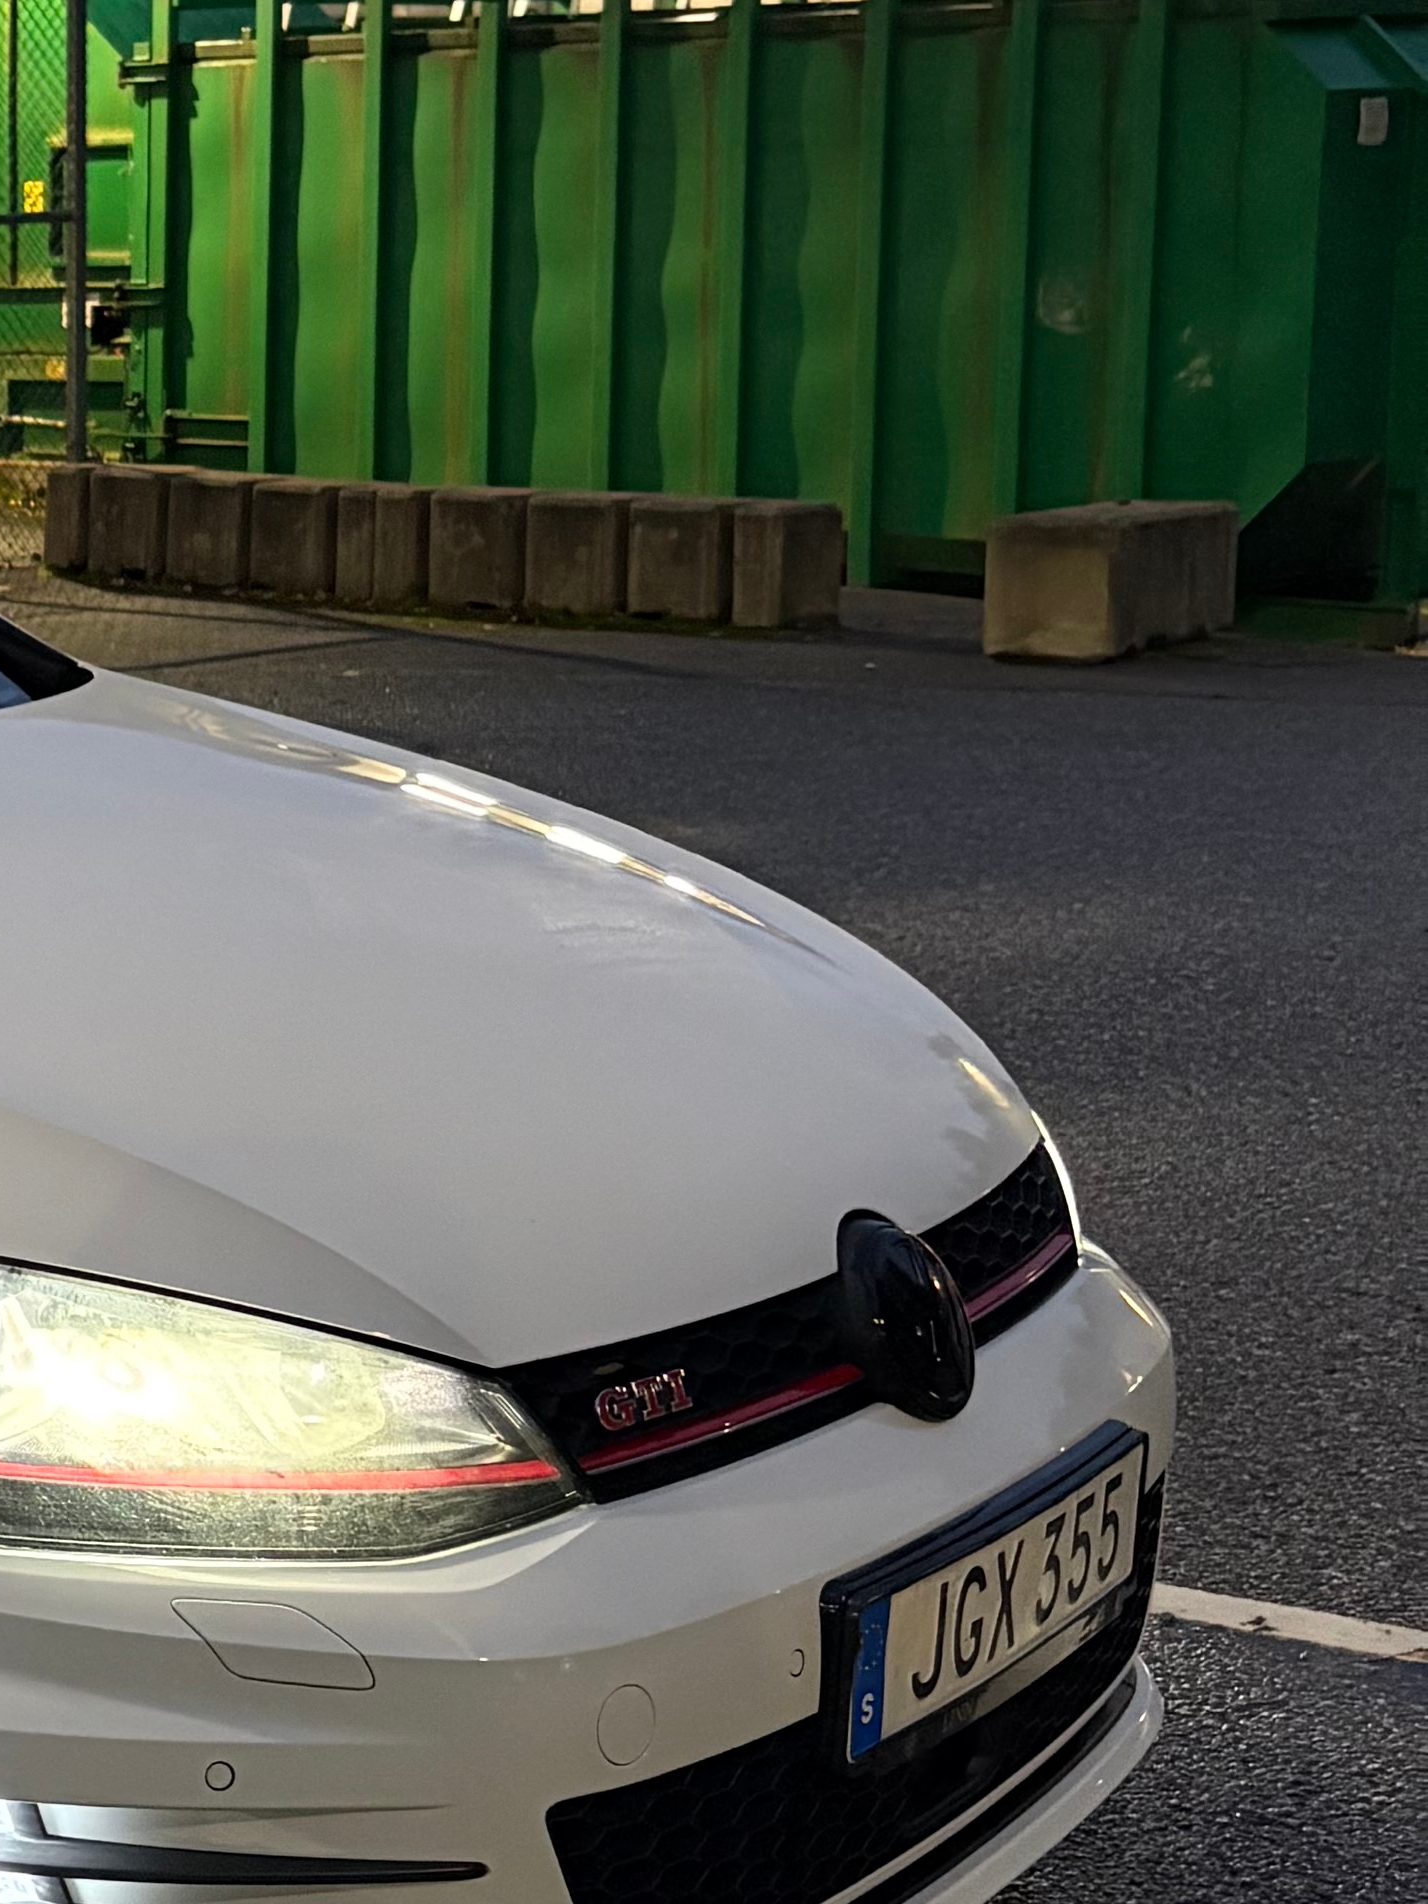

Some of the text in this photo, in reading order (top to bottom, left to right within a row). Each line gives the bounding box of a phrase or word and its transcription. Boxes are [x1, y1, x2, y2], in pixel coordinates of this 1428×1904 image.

[594, 1368, 693, 1431] GTI
[911, 1473, 1124, 1700] JGX 355
[860, 1692, 875, 1724] S
